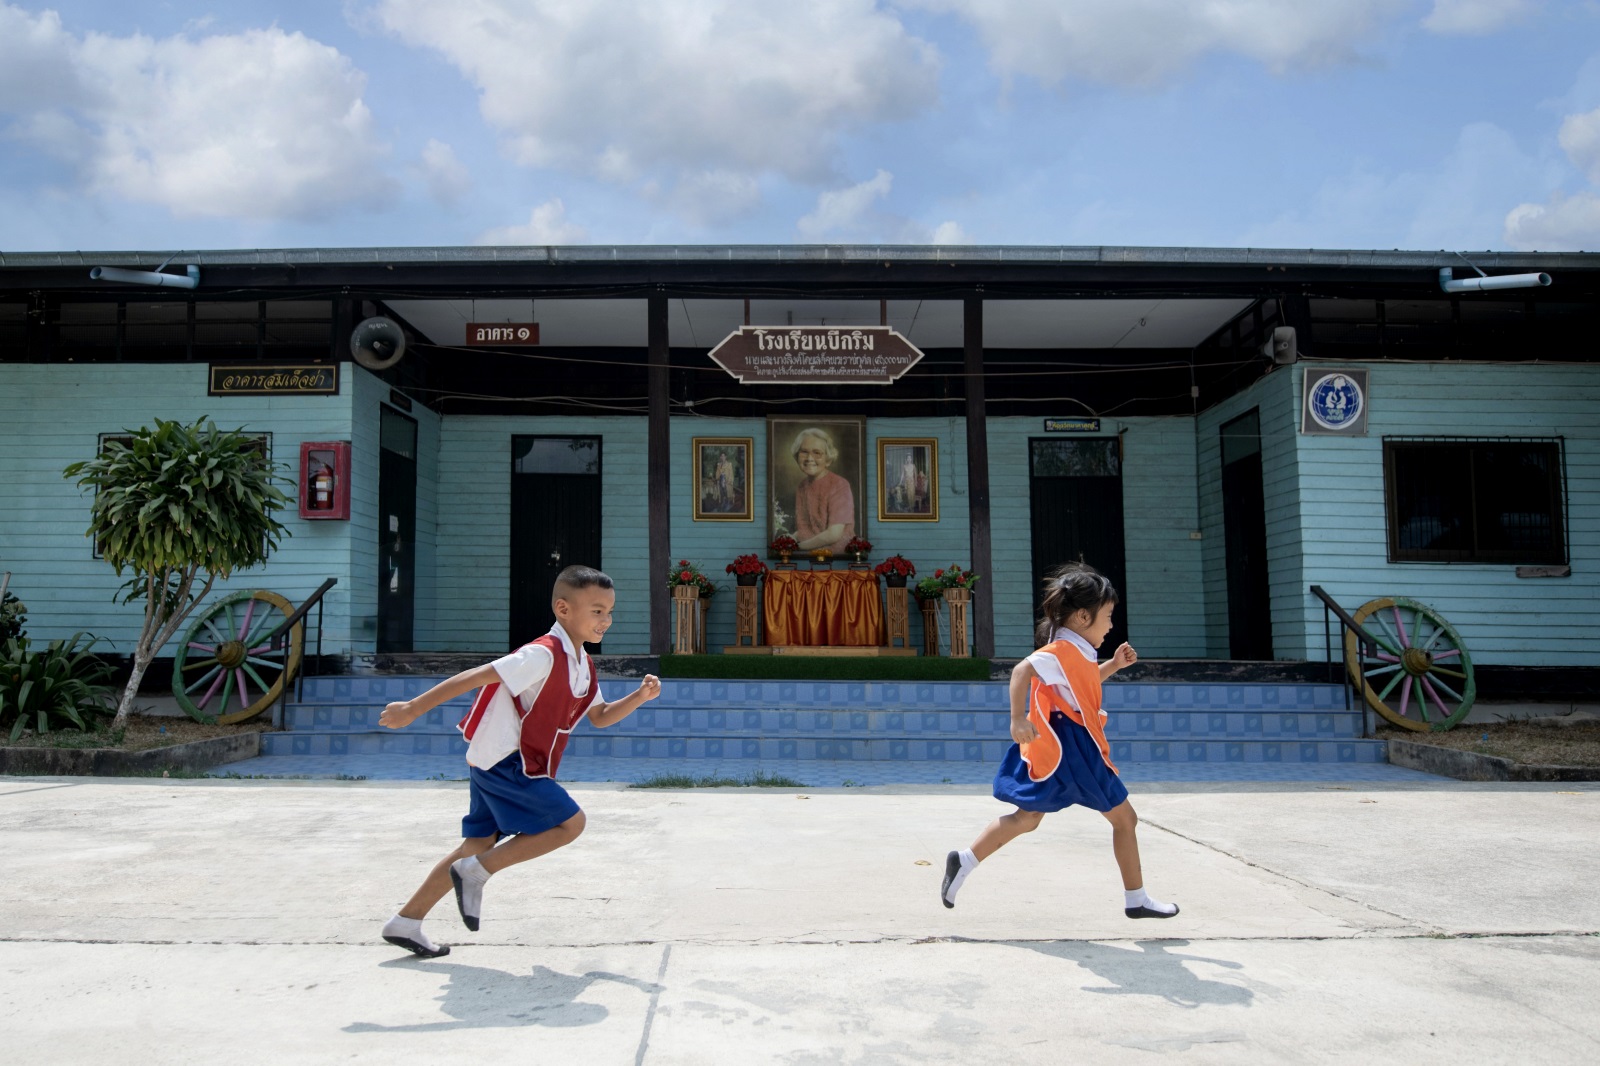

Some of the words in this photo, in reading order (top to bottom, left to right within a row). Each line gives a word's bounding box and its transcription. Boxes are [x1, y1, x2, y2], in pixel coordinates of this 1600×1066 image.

[476, 327, 514, 341] อาคาร
[517, 327, 531, 341] ๑
[753, 329, 874, 351] โรงเรียนบีกริม
[222, 369, 325, 390] อาคารสมเด็จย่า
